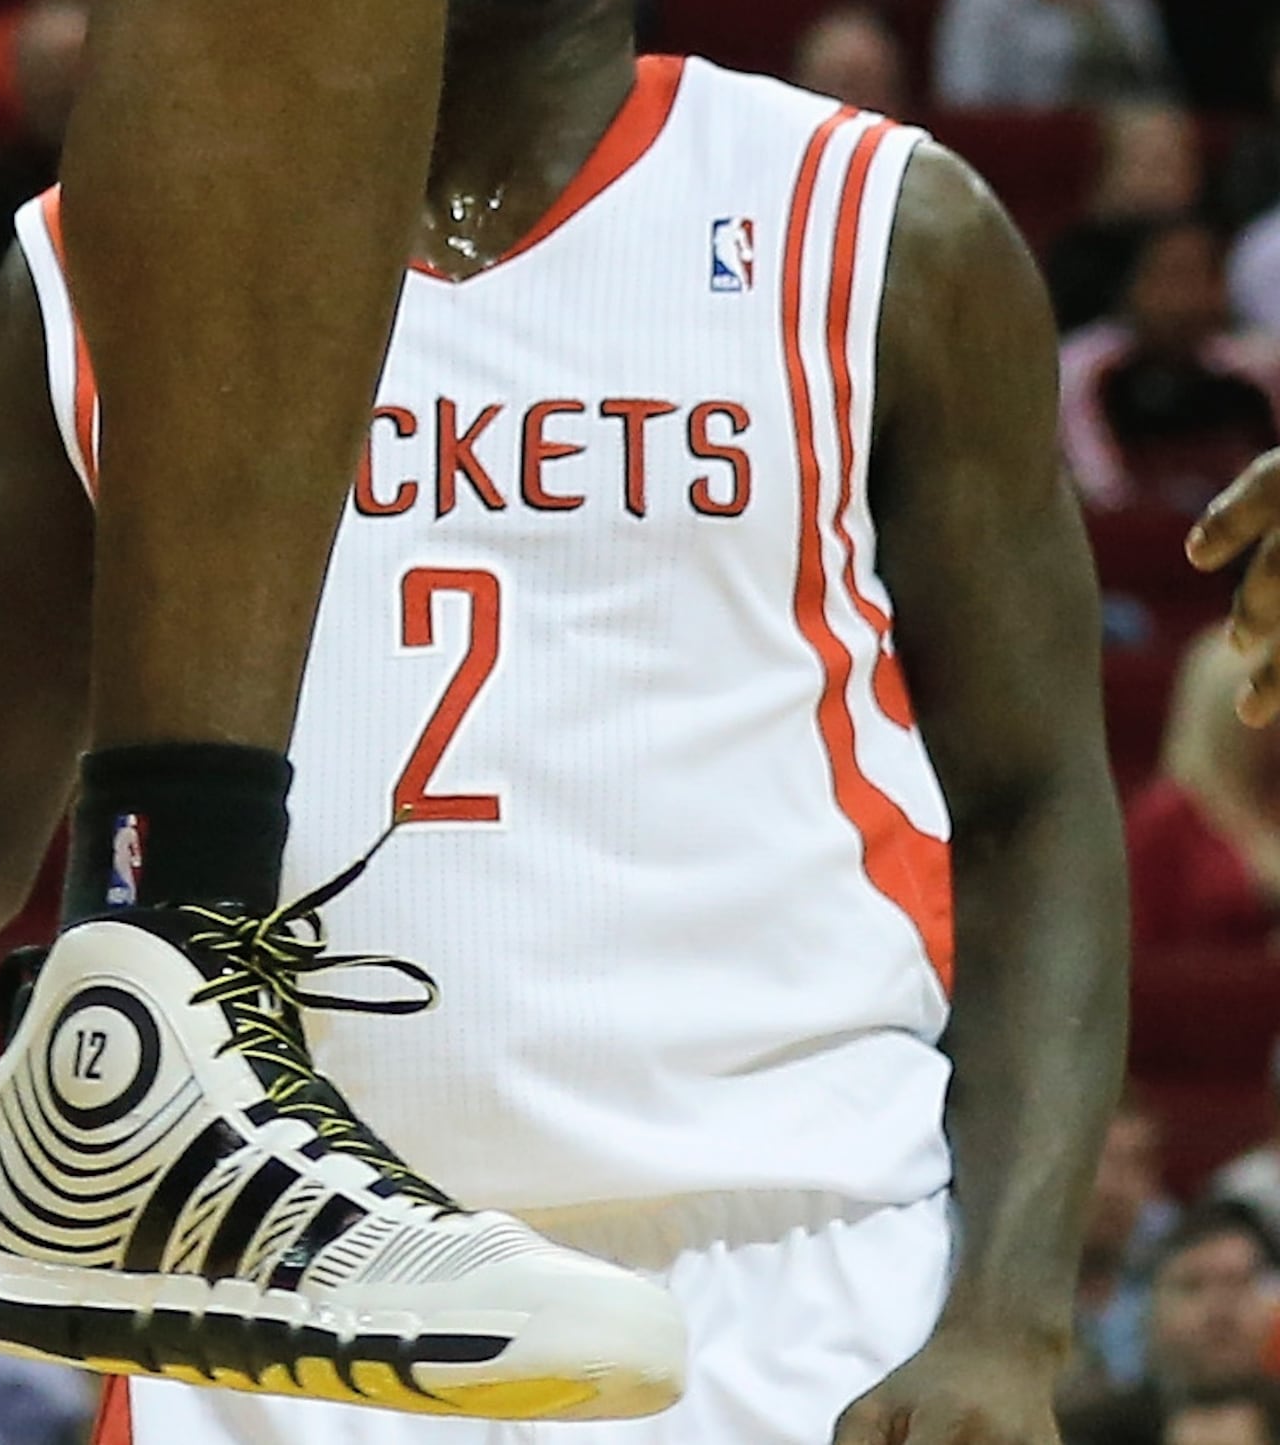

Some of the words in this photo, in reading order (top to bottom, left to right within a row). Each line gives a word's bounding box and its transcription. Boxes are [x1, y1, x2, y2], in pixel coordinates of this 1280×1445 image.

[353, 395, 752, 521] CKETS
[392, 566, 502, 824] 2
[73, 1030, 107, 1079] 12
